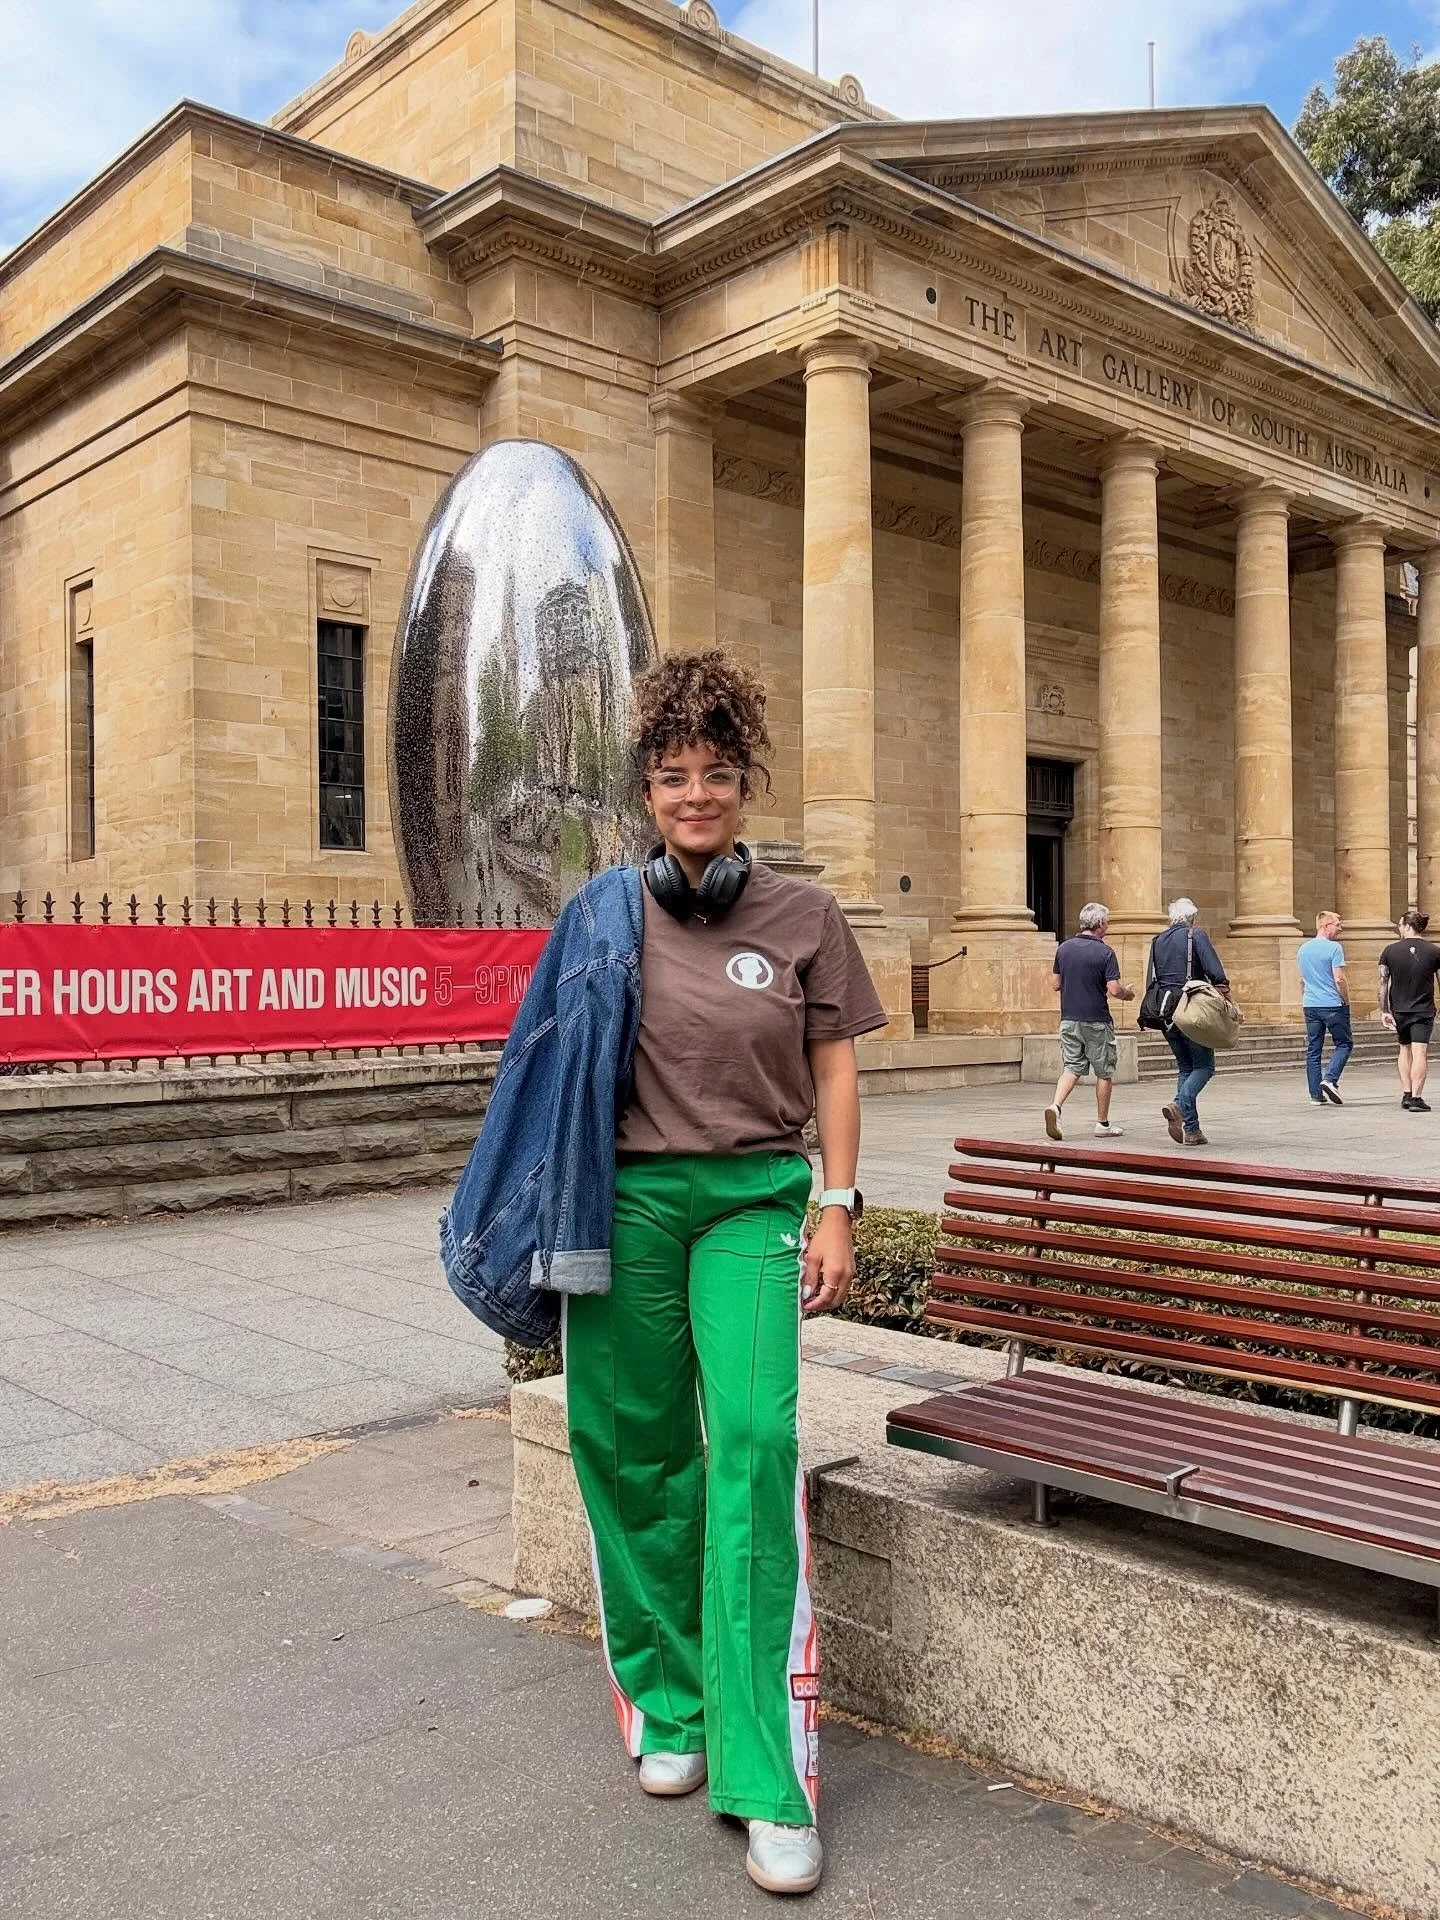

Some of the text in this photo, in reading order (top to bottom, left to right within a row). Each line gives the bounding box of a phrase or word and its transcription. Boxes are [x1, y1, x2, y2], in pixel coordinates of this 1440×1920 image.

[965, 296, 1409, 494] THE ART GALLERY OF SOUTH AUSTRALIA
[0, 968, 42, 1016] ER
[53, 968, 178, 1016] HOURS
[187, 968, 253, 1013] ART
[258, 967, 325, 1011] AND
[335, 966, 427, 1009] MUSIC
